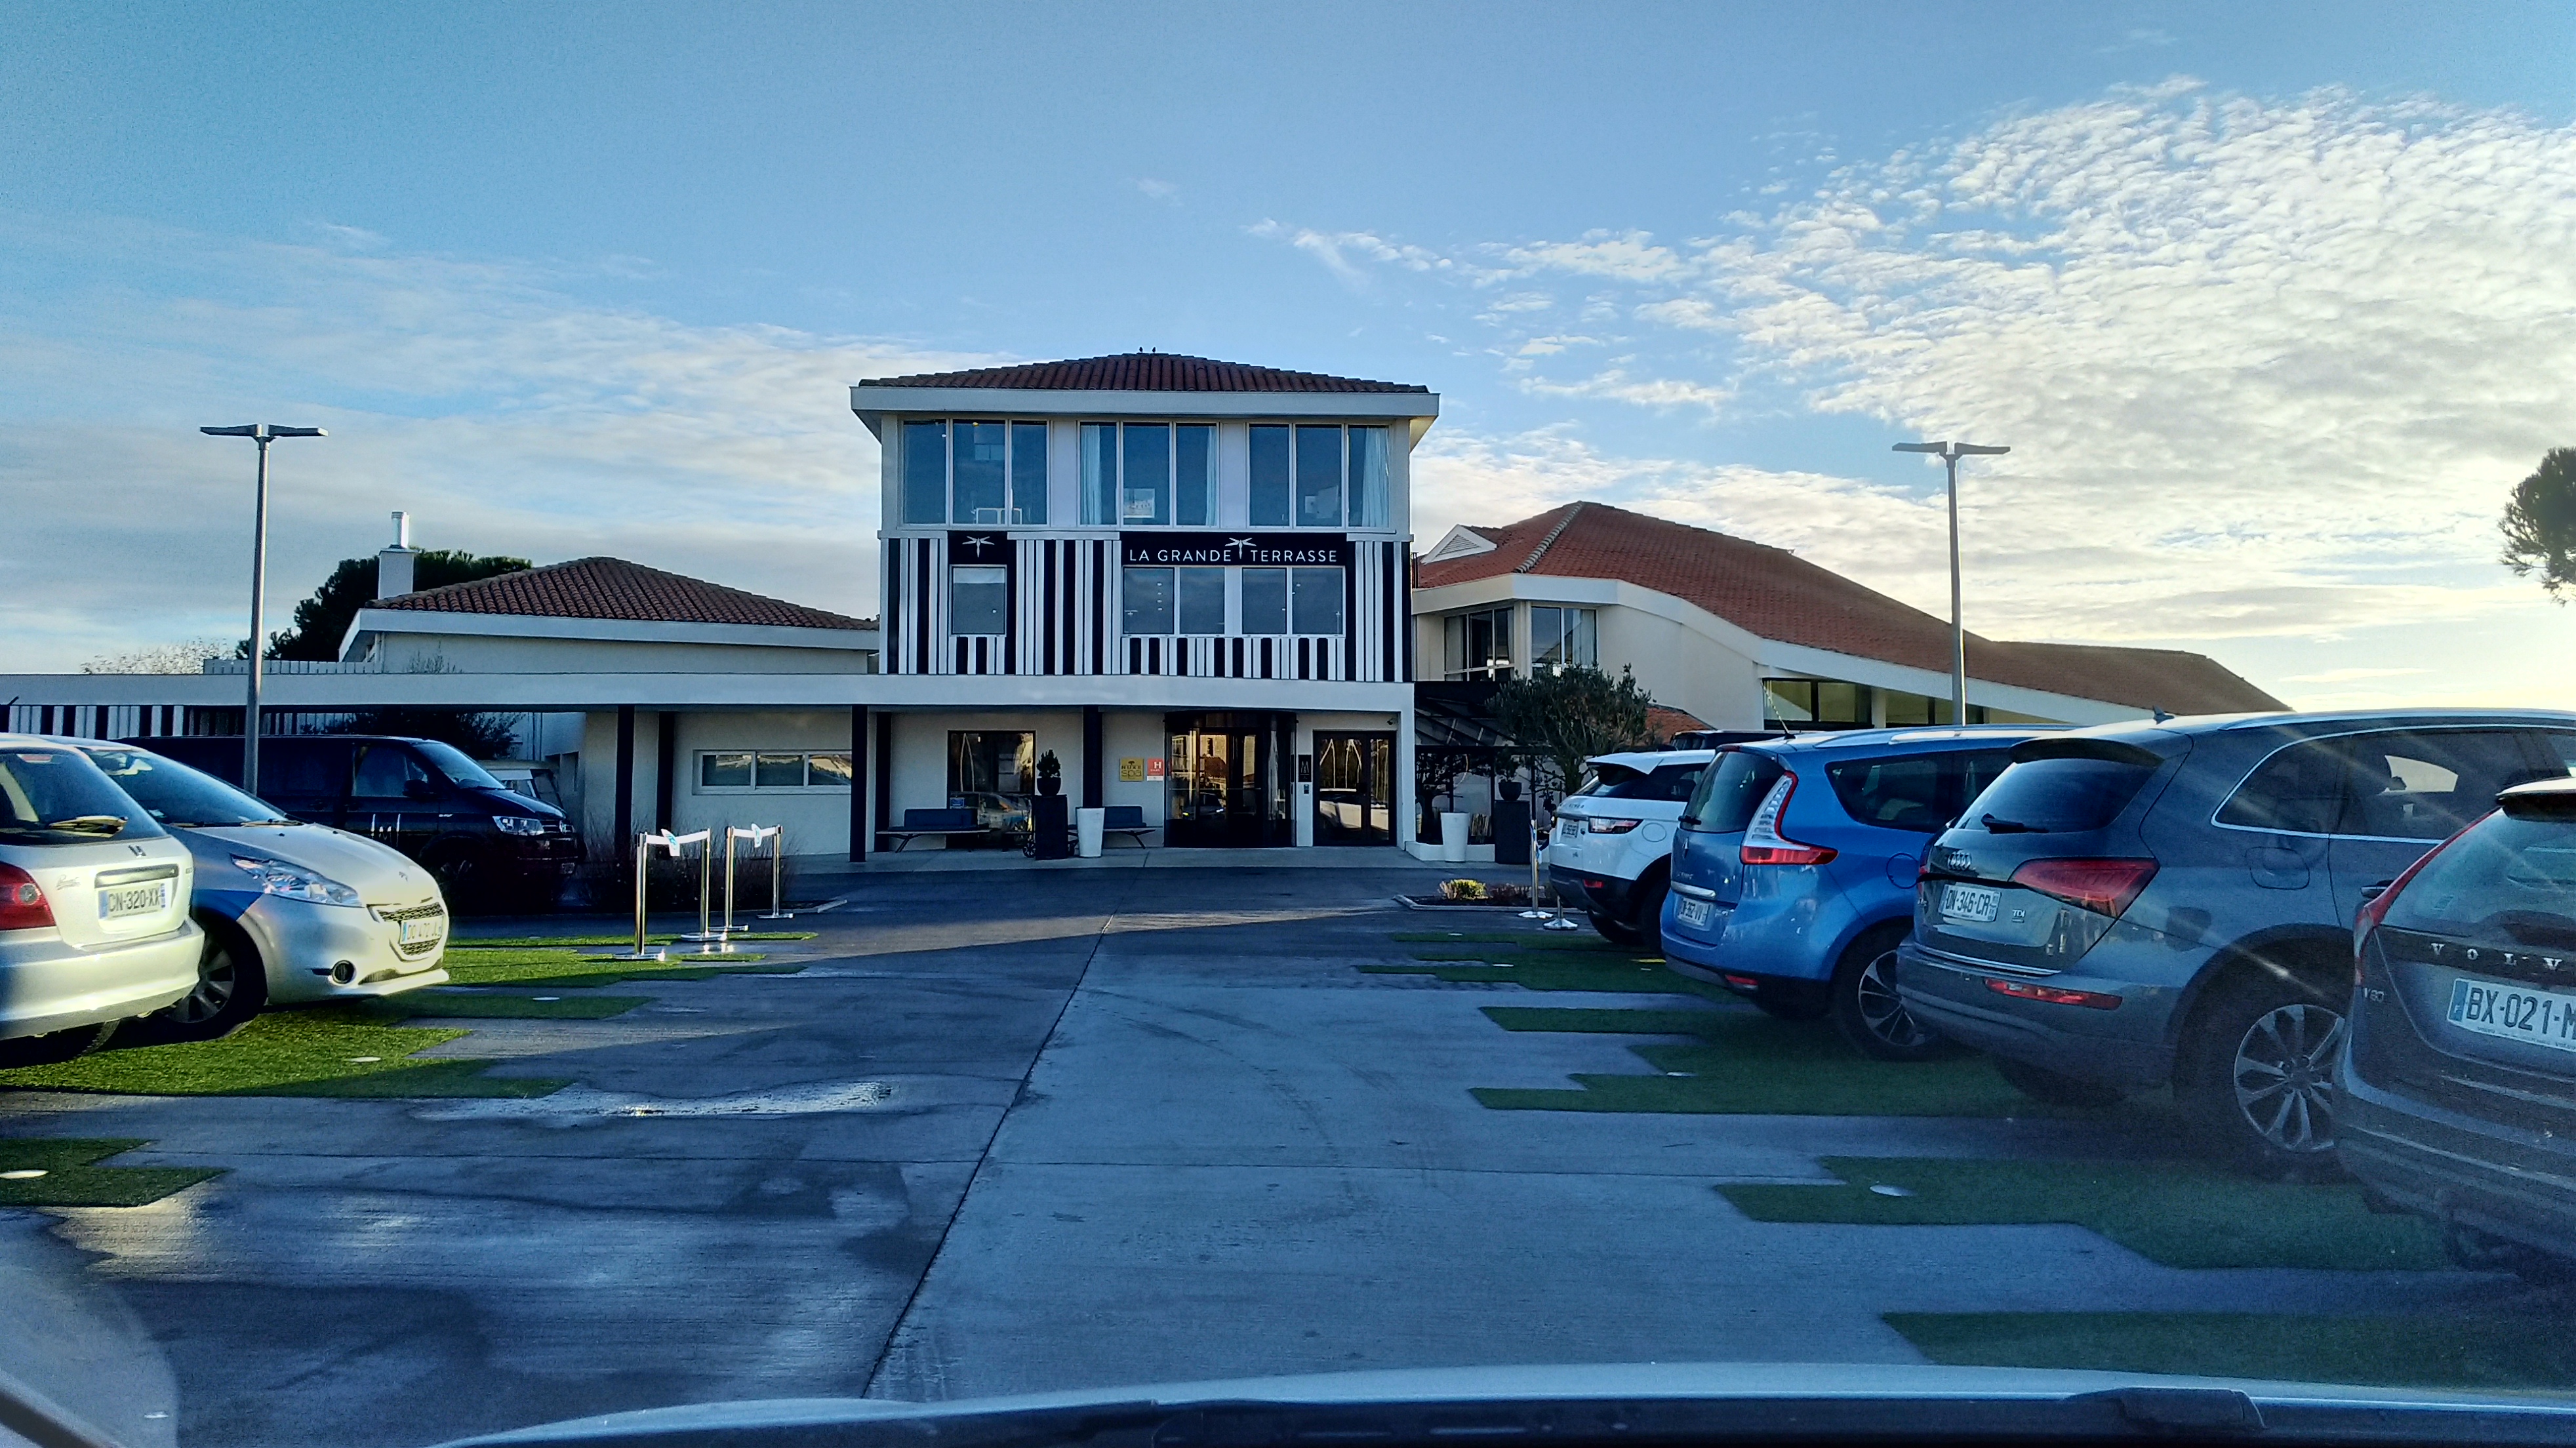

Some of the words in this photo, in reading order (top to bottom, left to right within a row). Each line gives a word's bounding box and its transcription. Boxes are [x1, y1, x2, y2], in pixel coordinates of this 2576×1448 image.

[1129, 550, 1150, 561] LA
[1157, 550, 1232, 562] GRANDE
[1250, 550, 1337, 563] TERRASSE
[1121, 770, 1142, 779] spa
[108, 889, 161, 912] CN-320-XX
[1945, 889, 1991, 916] DN-346-CR
[2012, 909, 2026, 917] TDI
